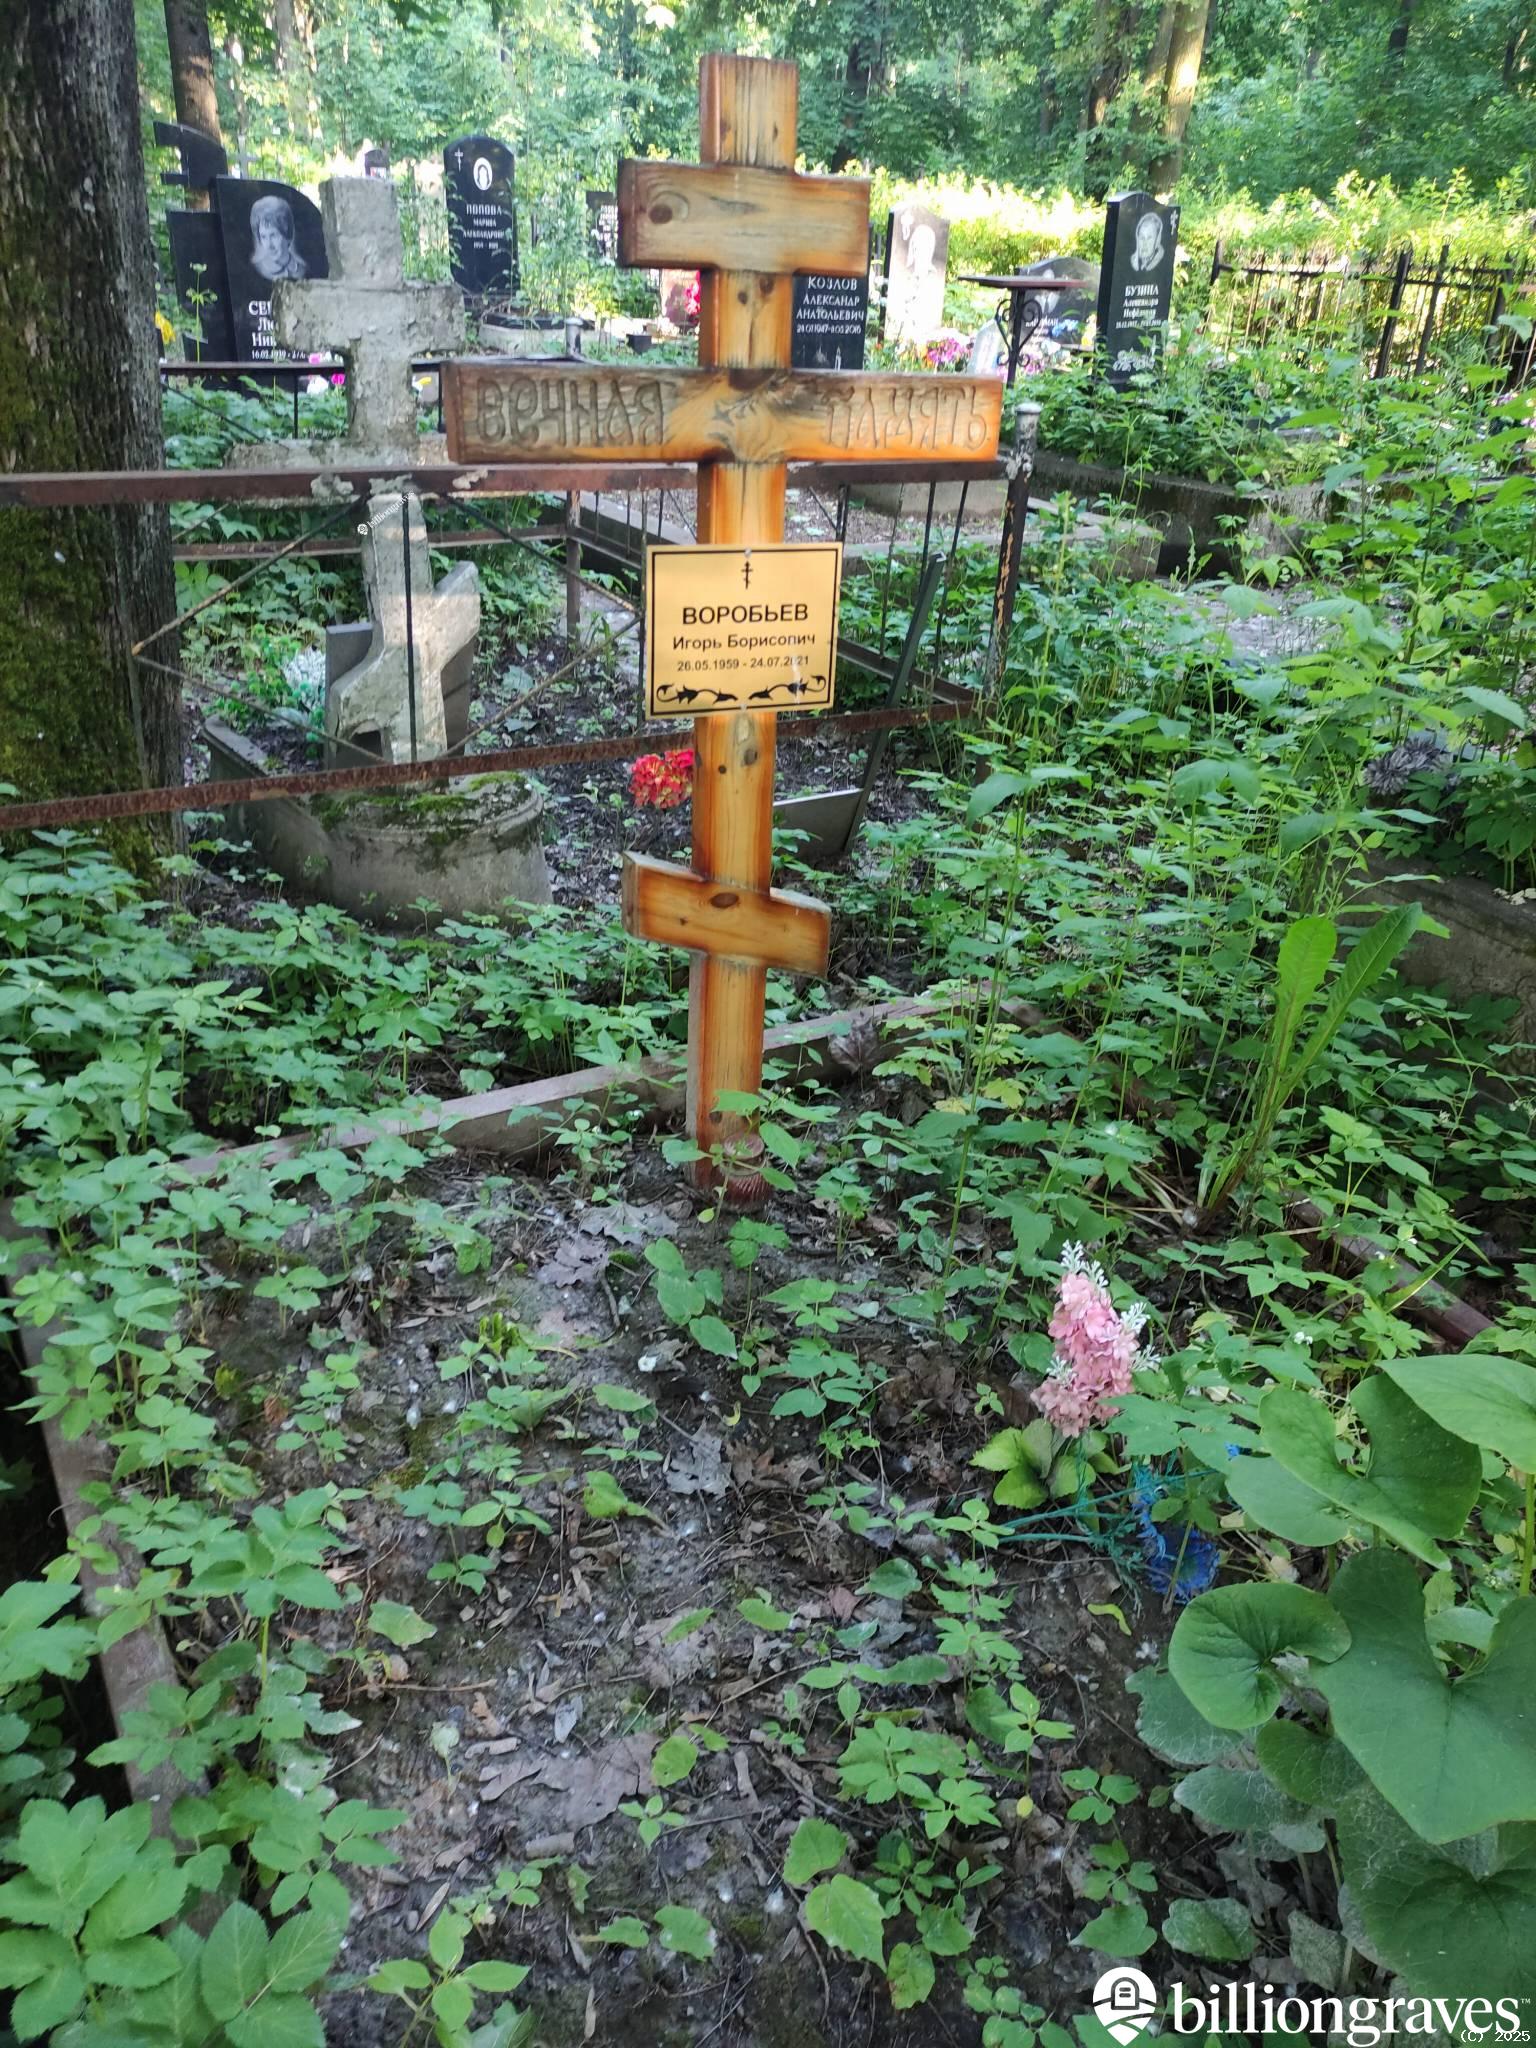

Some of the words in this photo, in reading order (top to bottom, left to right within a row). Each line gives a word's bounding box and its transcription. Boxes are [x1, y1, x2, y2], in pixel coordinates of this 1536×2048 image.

[466, 203, 502, 216] ПОПОВА
[808, 276, 858, 291] КОЗЛОВ
[803, 293, 860, 307] АЛЕКСАНДР
[796, 308, 864, 322] АНАТОЛЬЕВИЧ
[476, 376, 664, 448] ВЕЧНАЯ
[822, 385, 987, 451] ПАМЯТЬ
[682, 603, 809, 625] ВОРОБЬЕВ
[672, 636, 723, 651] Игорь
[677, 659, 740, 672] 26.05.1959
